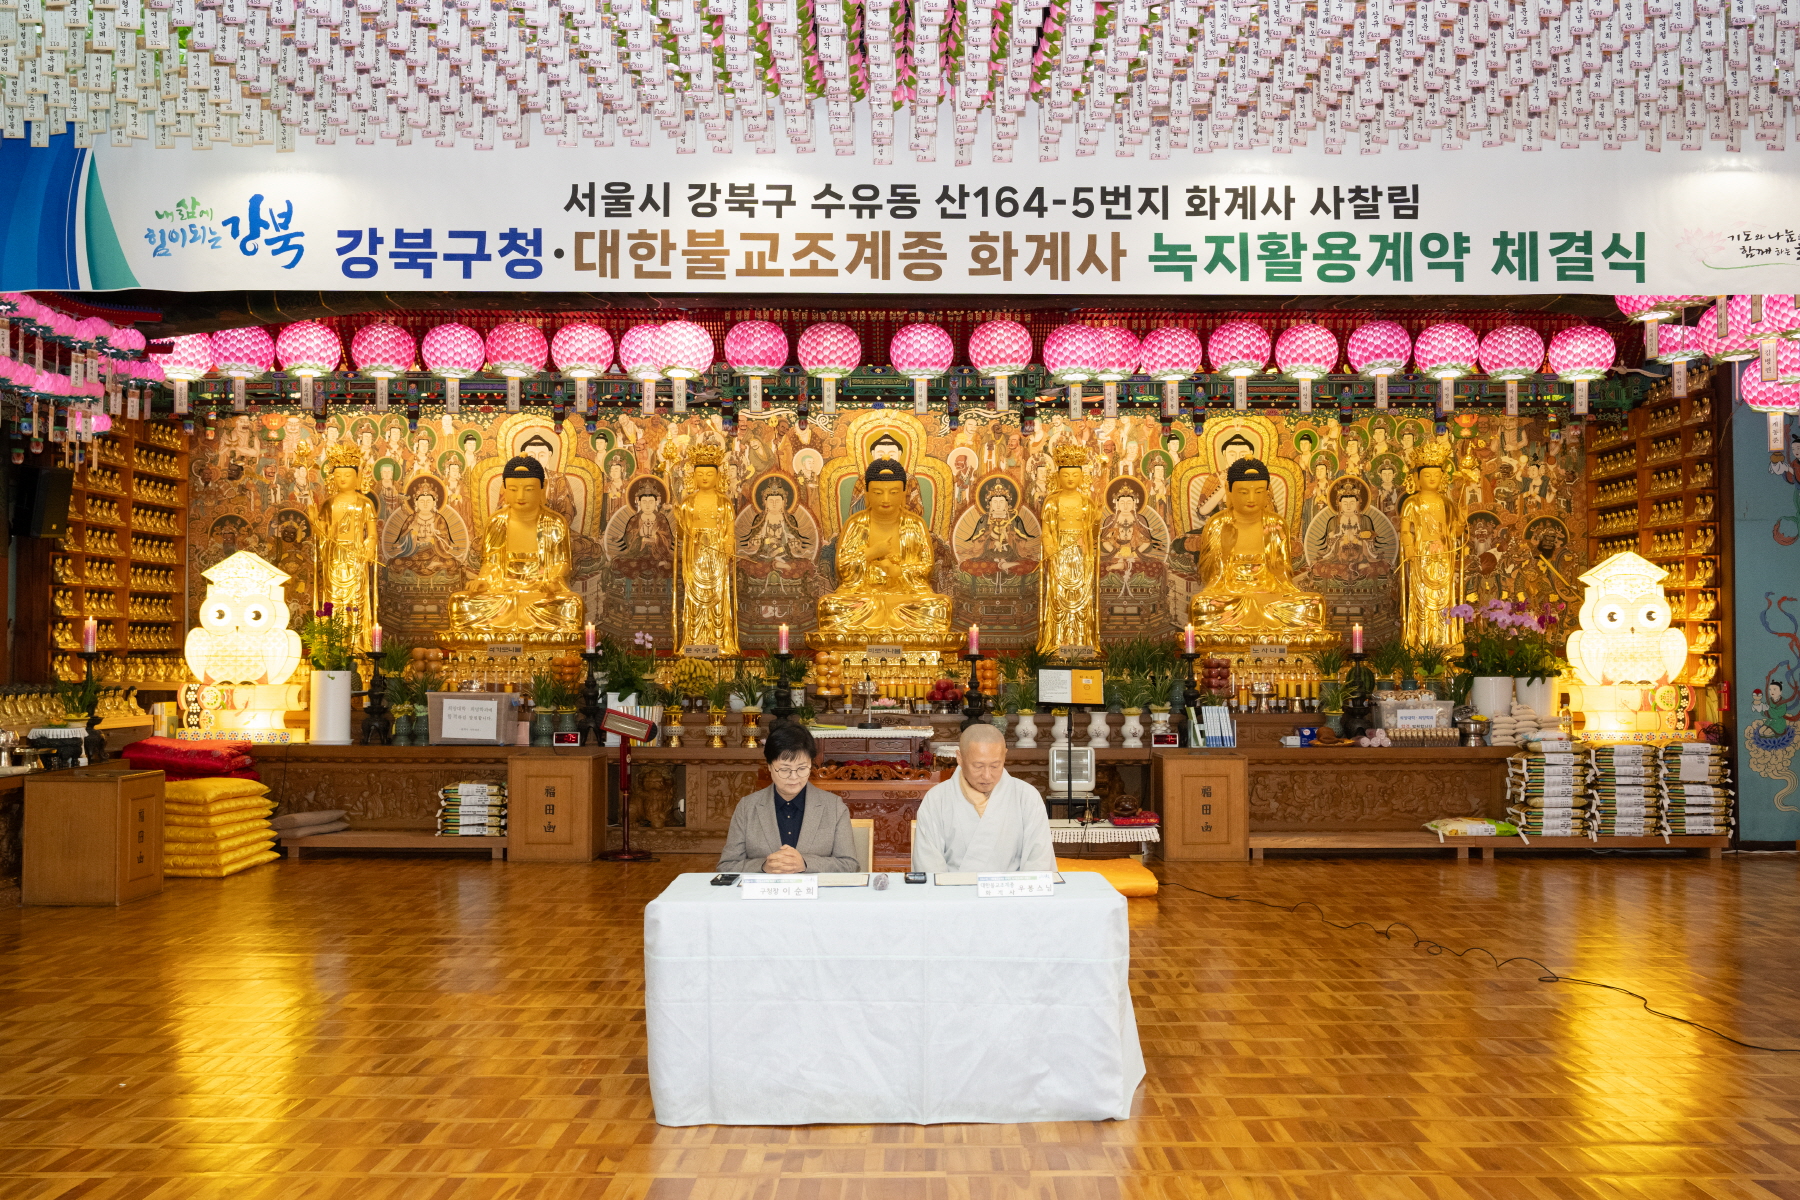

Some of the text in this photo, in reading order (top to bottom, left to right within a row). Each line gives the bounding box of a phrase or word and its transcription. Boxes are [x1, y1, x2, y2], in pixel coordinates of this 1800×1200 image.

[1371, 2, 1379, 28] 이상규
[564, 182, 1420, 221] 서울시 강북구 수유동 산164-5번지 화계사 사찰림
[221, 194, 305, 270] 강북
[968, 231, 1127, 282] 화계사
[1149, 232, 1471, 283] 녹지활용계약
[1491, 231, 1646, 284] 체결식
